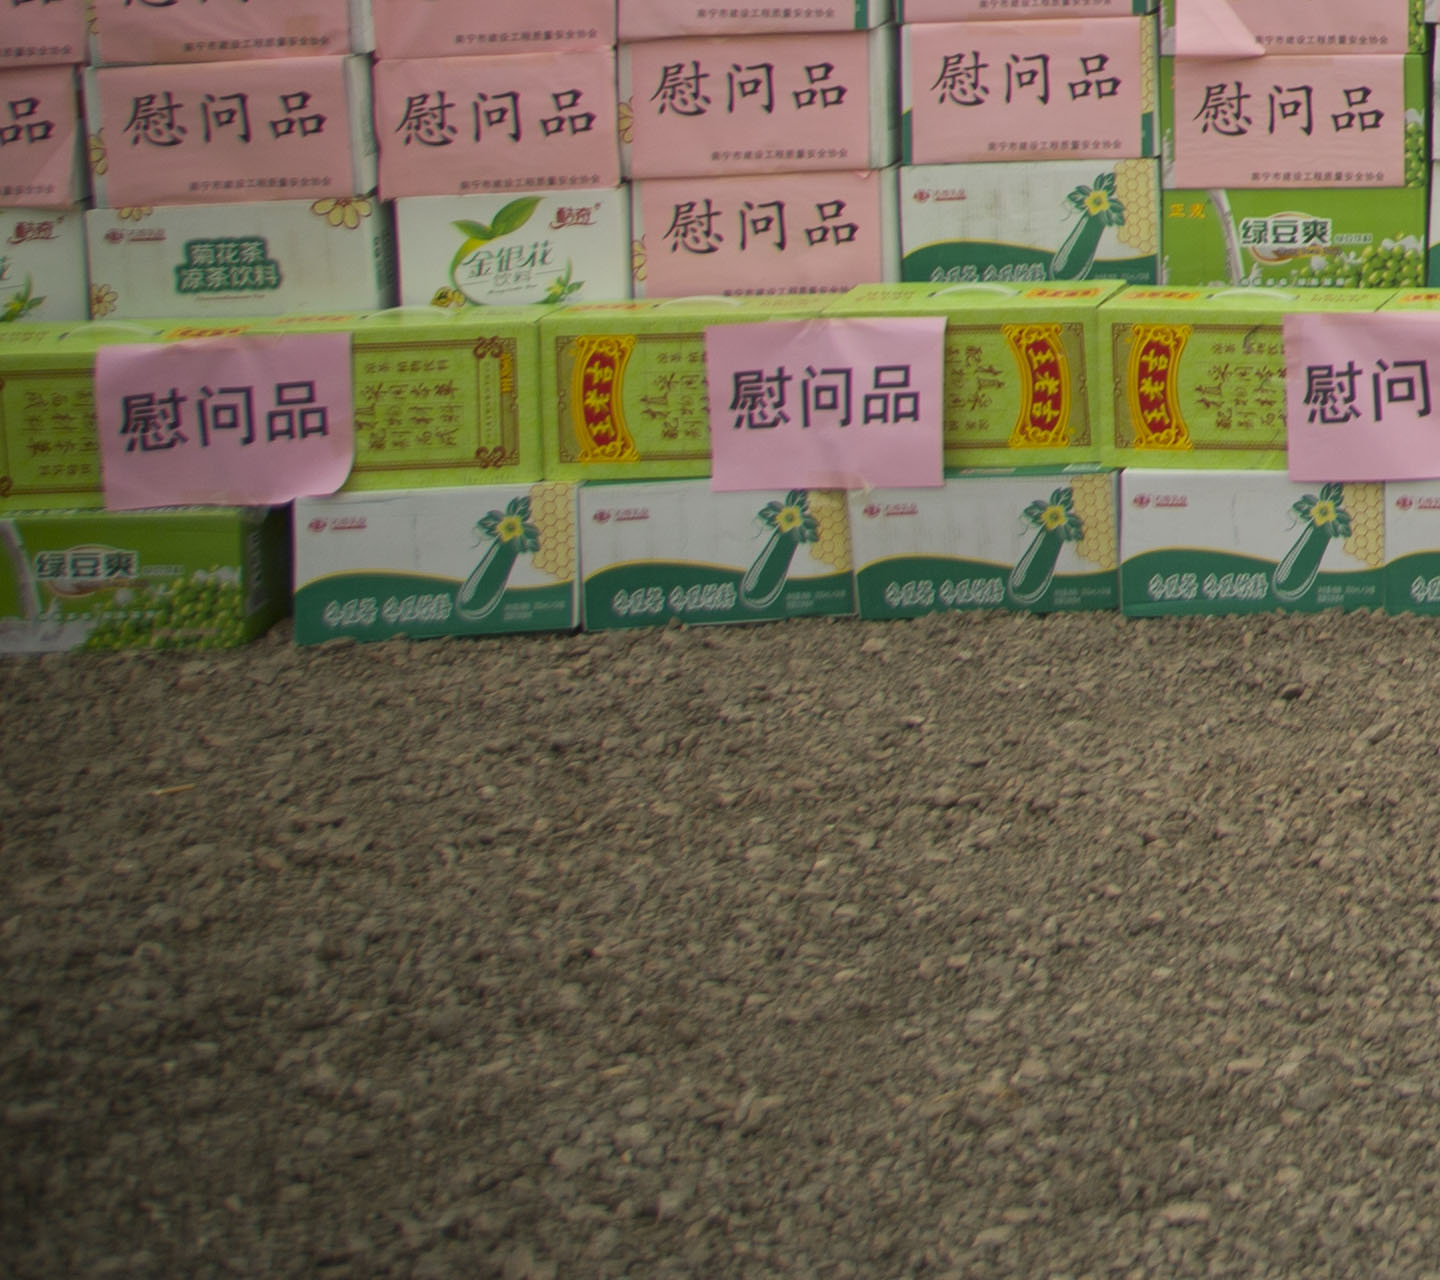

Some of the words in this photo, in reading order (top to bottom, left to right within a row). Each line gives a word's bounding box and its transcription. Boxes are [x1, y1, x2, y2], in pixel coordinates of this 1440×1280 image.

[1255, 34, 1389, 46] 南宁市建设工程质量安全协会
[651, 61, 847, 116] 慰问品
[931, 51, 1121, 106] 慰问品
[124, 92, 326, 147] 慰问品
[396, 89, 596, 146] 慰问品
[1194, 82, 1384, 136] 慰问品
[987, 139, 1122, 155] 南宁市建设工程质量安全协会
[1249, 168, 1387, 185] 南宁市建设工程质量安全协会
[664, 199, 858, 254] 慰问品
[1240, 219, 1330, 245] 绿豆爽
[463, 241, 553, 277] 金银花
[588, 361, 615, 444] 王老吉
[730, 365, 919, 429] 慰问品
[1031, 341, 1061, 432] 王老吉
[1139, 349, 1170, 429] 王老吉
[120, 381, 328, 451] 慰问品
[36, 552, 134, 579] 绿豆爽
